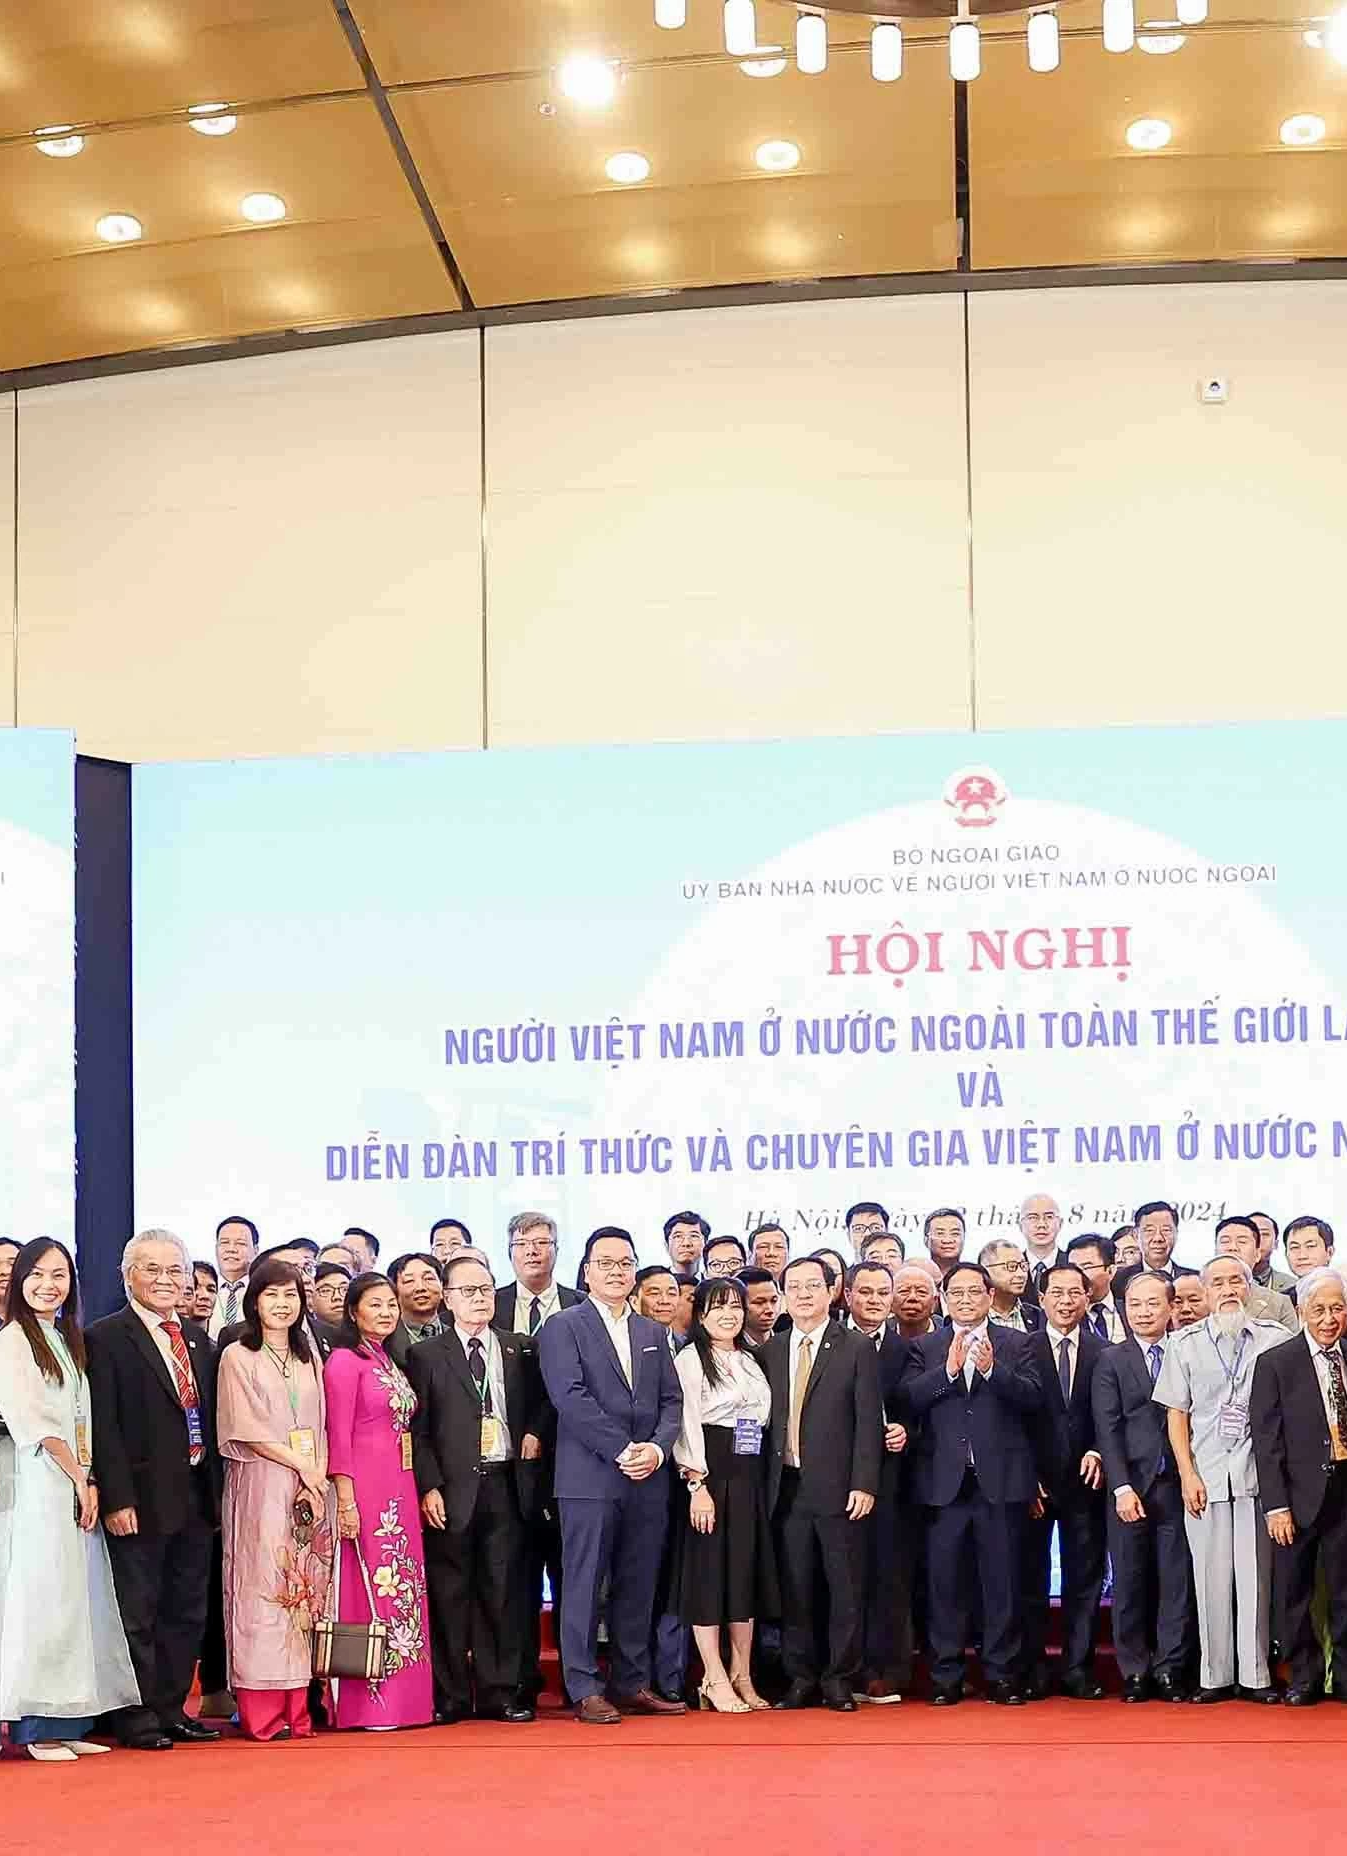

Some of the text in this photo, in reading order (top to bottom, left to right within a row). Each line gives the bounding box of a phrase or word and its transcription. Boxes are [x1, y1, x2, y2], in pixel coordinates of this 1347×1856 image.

[1006, 844, 1060, 862] GIAO
[717, 880, 763, 898] BAN
[1059, 870, 1106, 887] NAM
[826, 920, 1133, 989] HỘI NGHỊ
[444, 1016, 557, 1065] NGƯỜI
[569, 1015, 647, 1071] VIỆT
[659, 1021, 744, 1059] NAM
[759, 1006, 782, 1057] Ở
[795, 1009, 897, 1056] NƯỚC
[910, 1004, 1026, 1052] NGOÀI
[1039, 1002, 1138, 1049] TOÀN
[1151, 994, 1221, 1046] THẾ
[1234, 998, 1309, 1044] GIỚI
[956, 1063, 1004, 1108] VÀ
[325, 1130, 410, 1181] DIỄN
[422, 1133, 497, 1179] ĐÀN
[510, 1130, 566, 1177] TRÍ
[579, 1129, 673, 1175] THỨC
[686, 1127, 733, 1173] VÀ
[745, 1123, 893, 1171] CHUYÊN
[907, 1129, 970, 1168] GIA
[981, 1119, 1061, 1173] VIỆT
[1074, 1124, 1161, 1163] NAM
[1176, 1110, 1201, 1161] Ở
[1213, 1112, 1317, 1160] NƯỚC
[1067, 1202, 1085, 1226] 8
